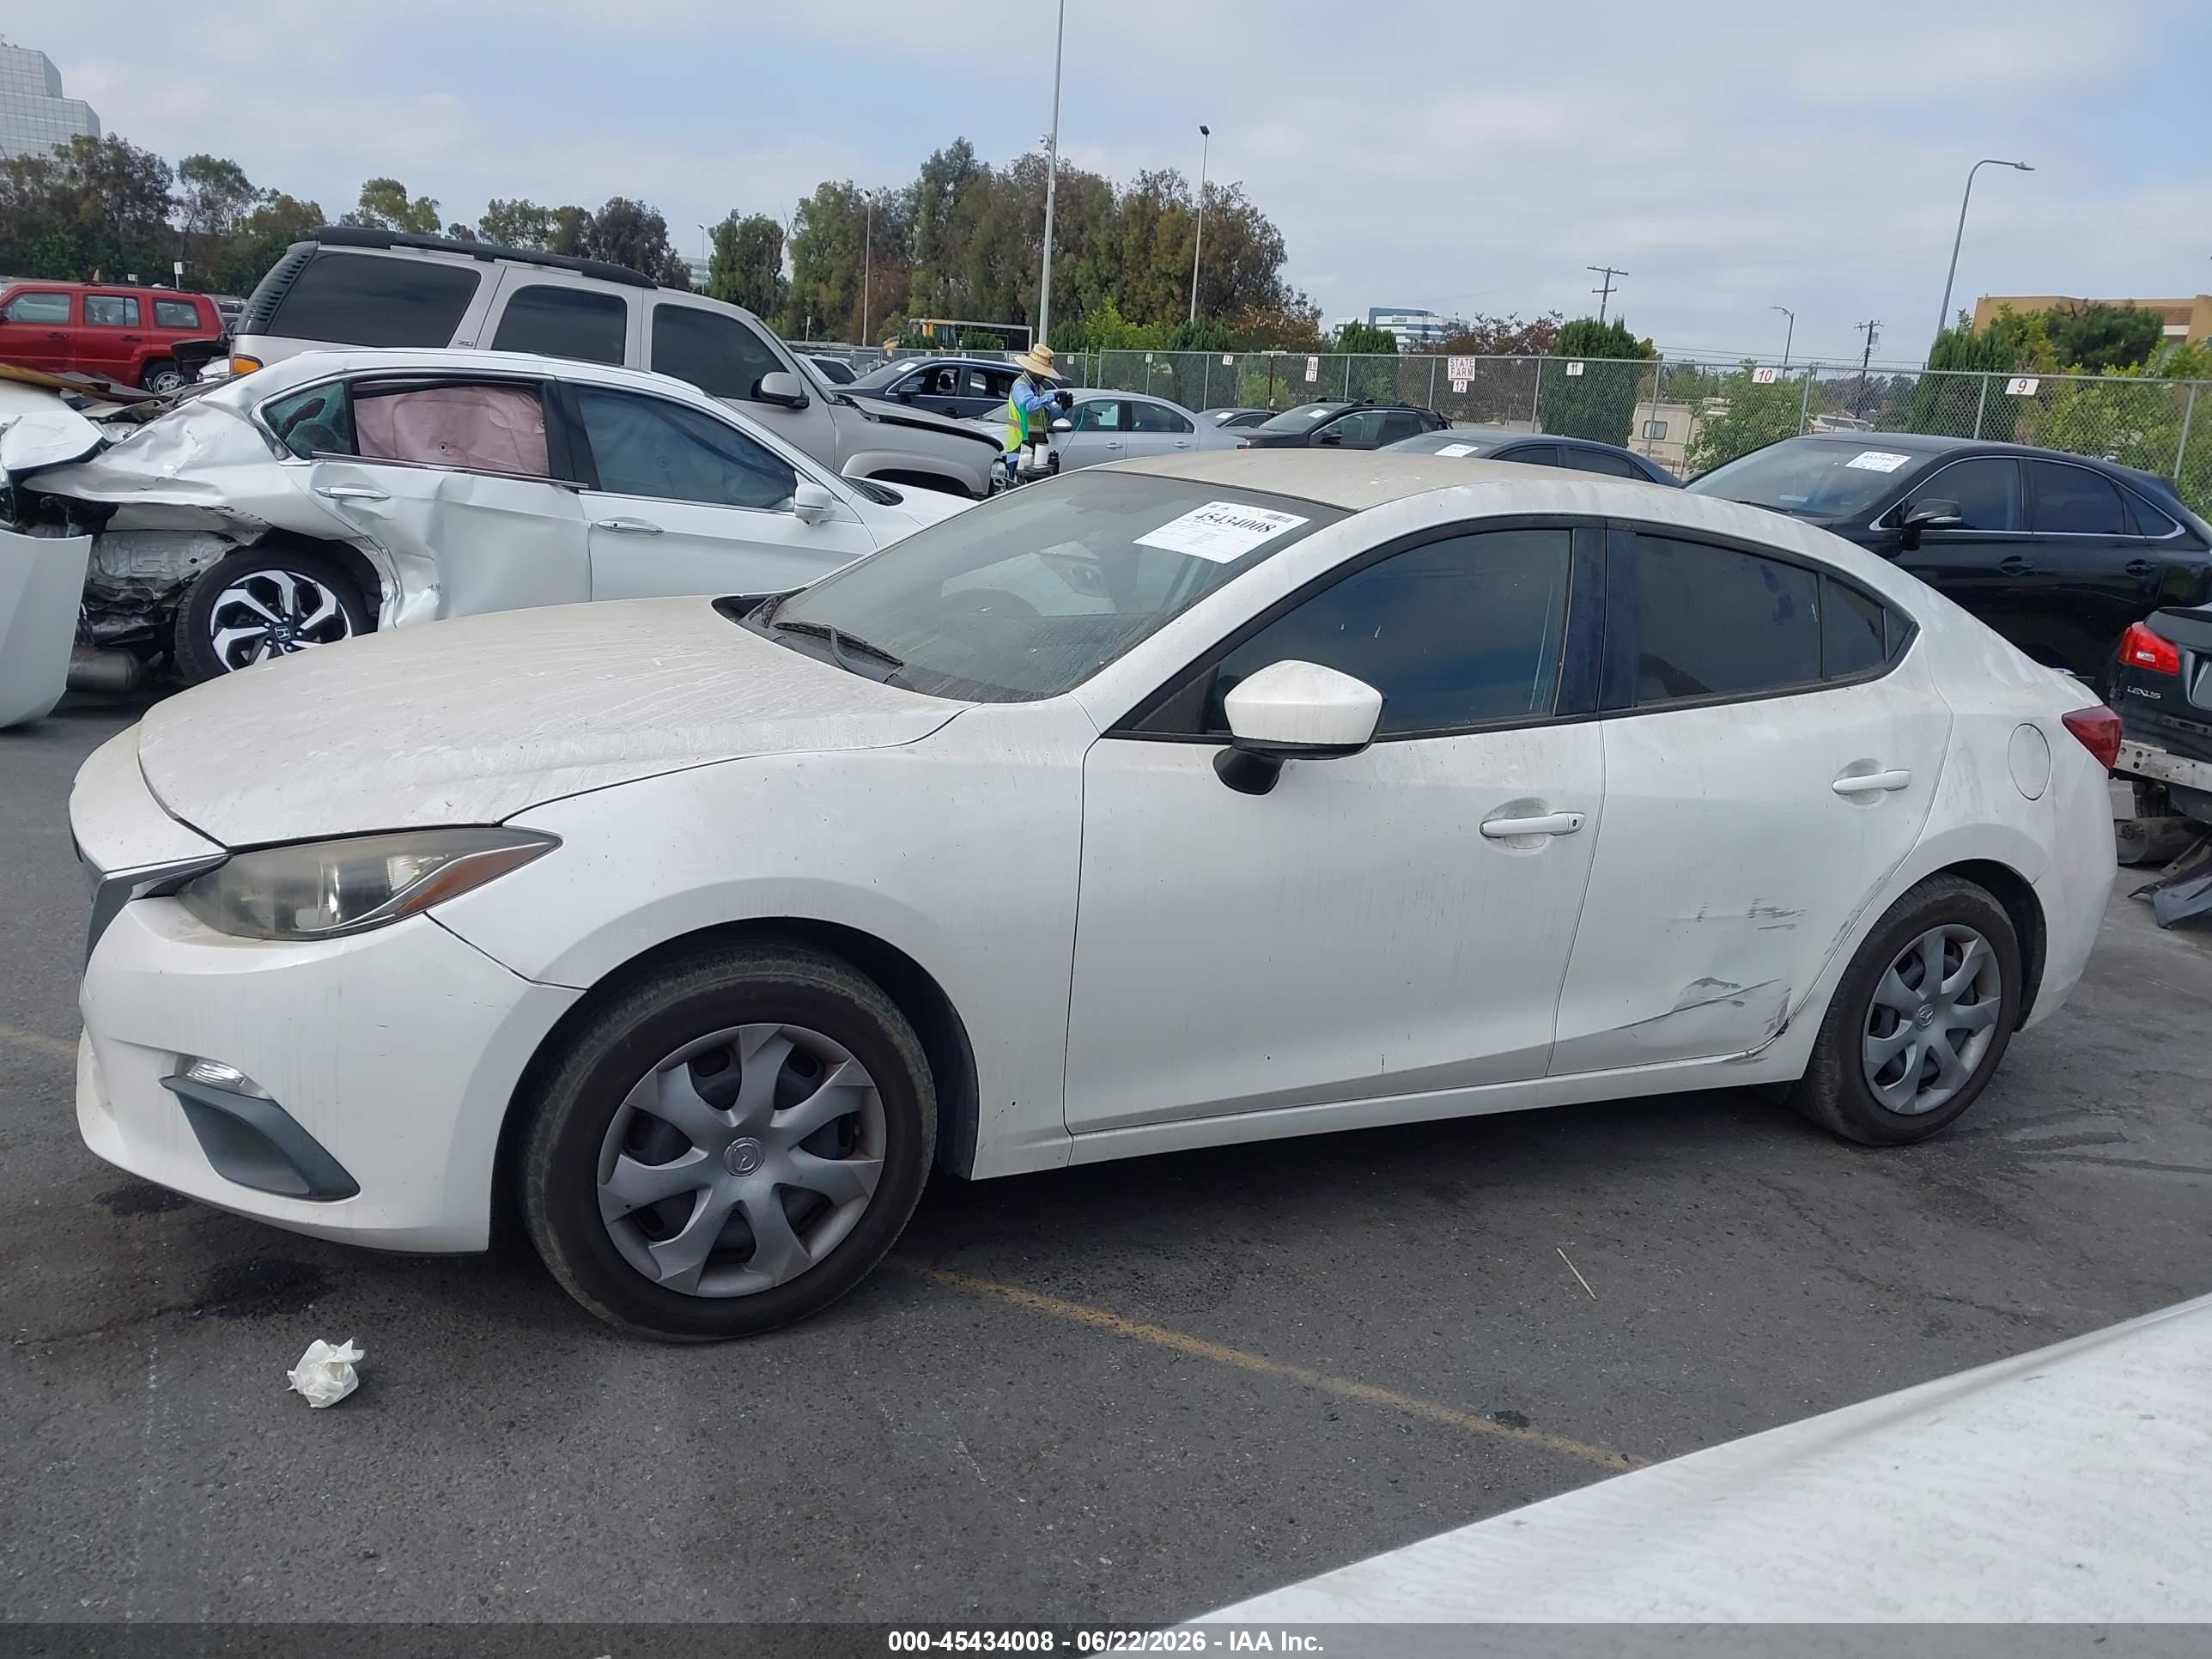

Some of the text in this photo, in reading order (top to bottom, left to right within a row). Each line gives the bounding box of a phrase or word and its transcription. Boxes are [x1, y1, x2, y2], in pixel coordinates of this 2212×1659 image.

[1449, 358, 1474, 368] STATE
[1571, 363, 1578, 374] 11
[1450, 368, 1474, 377] FARM
[1759, 369, 1773, 382] 10
[1455, 380, 1465, 392] 12
[2016, 380, 2027, 393] 9
[1194, 512, 1277, 533] 45434008
[2127, 685, 2161, 699] LEXUS
